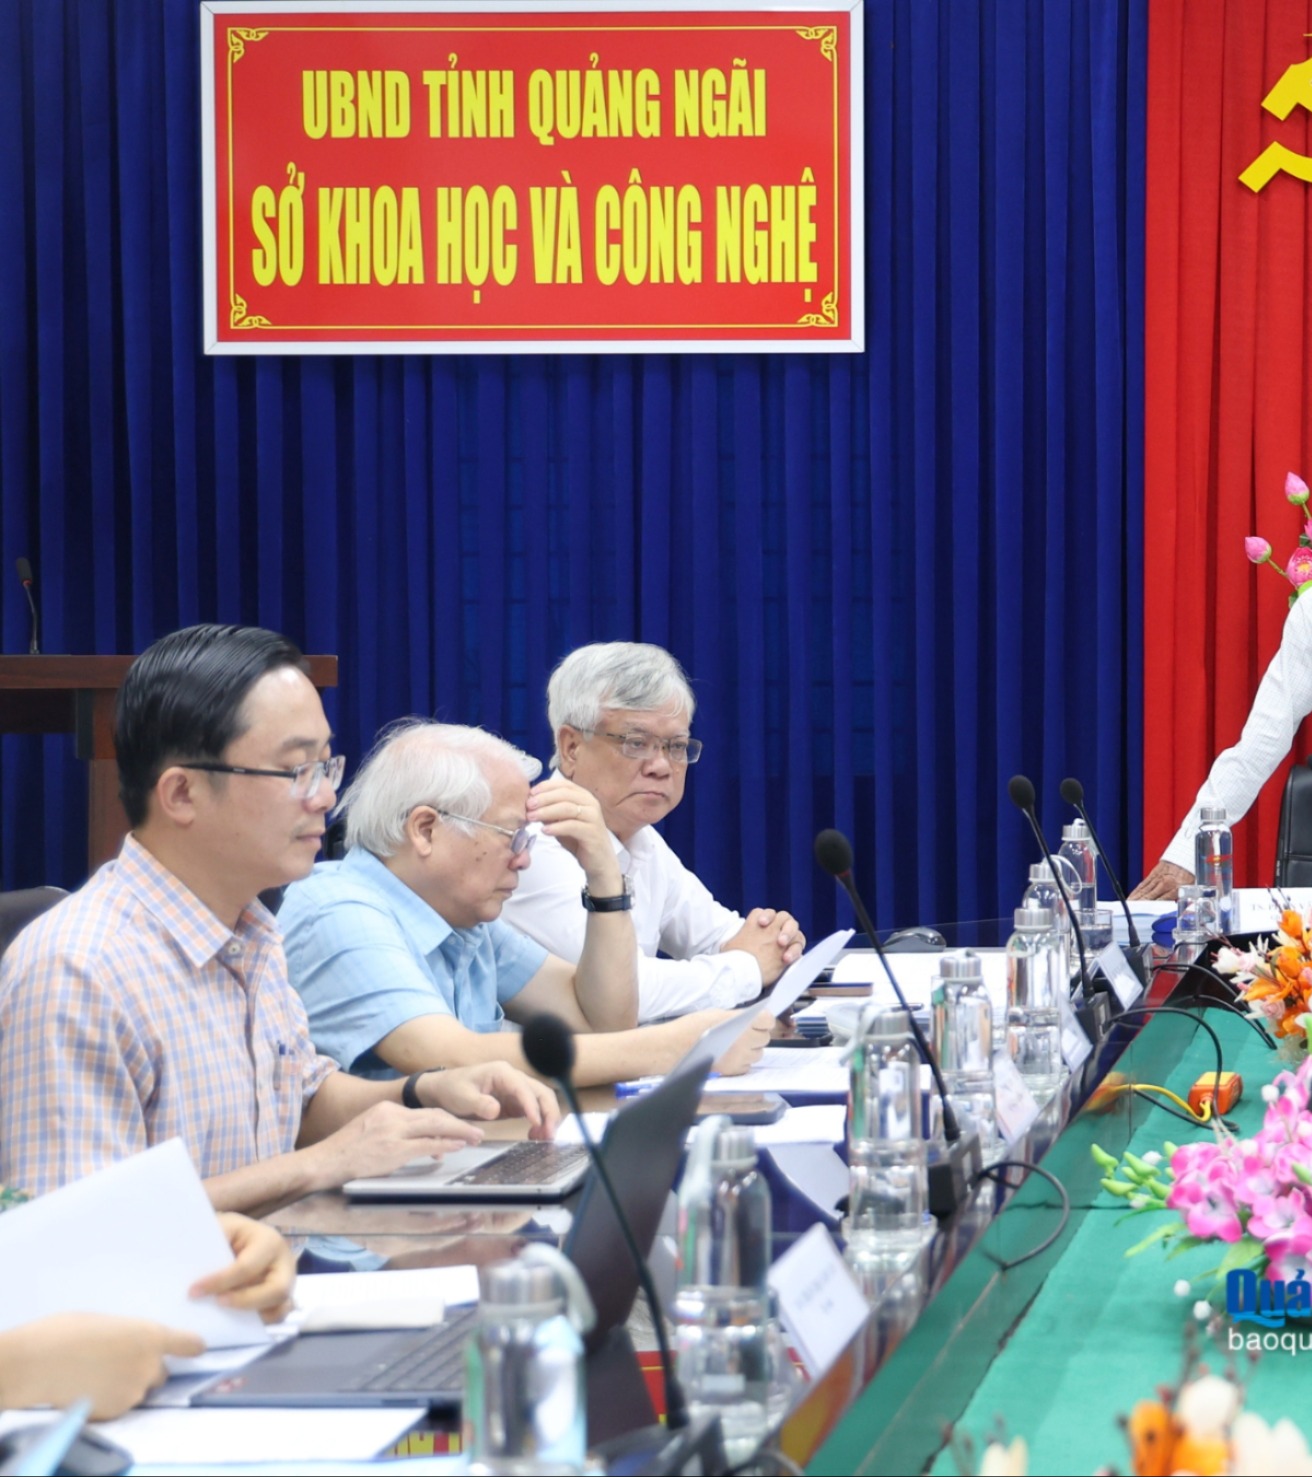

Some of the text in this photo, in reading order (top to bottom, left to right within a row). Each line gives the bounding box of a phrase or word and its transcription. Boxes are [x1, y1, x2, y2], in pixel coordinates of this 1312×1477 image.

[302, 52, 766, 146] UBND TỈNH QUẢNG NGÃI
[251, 161, 818, 304] SỞ KHOA HỌC VÀ CÔNG NGHỆ
